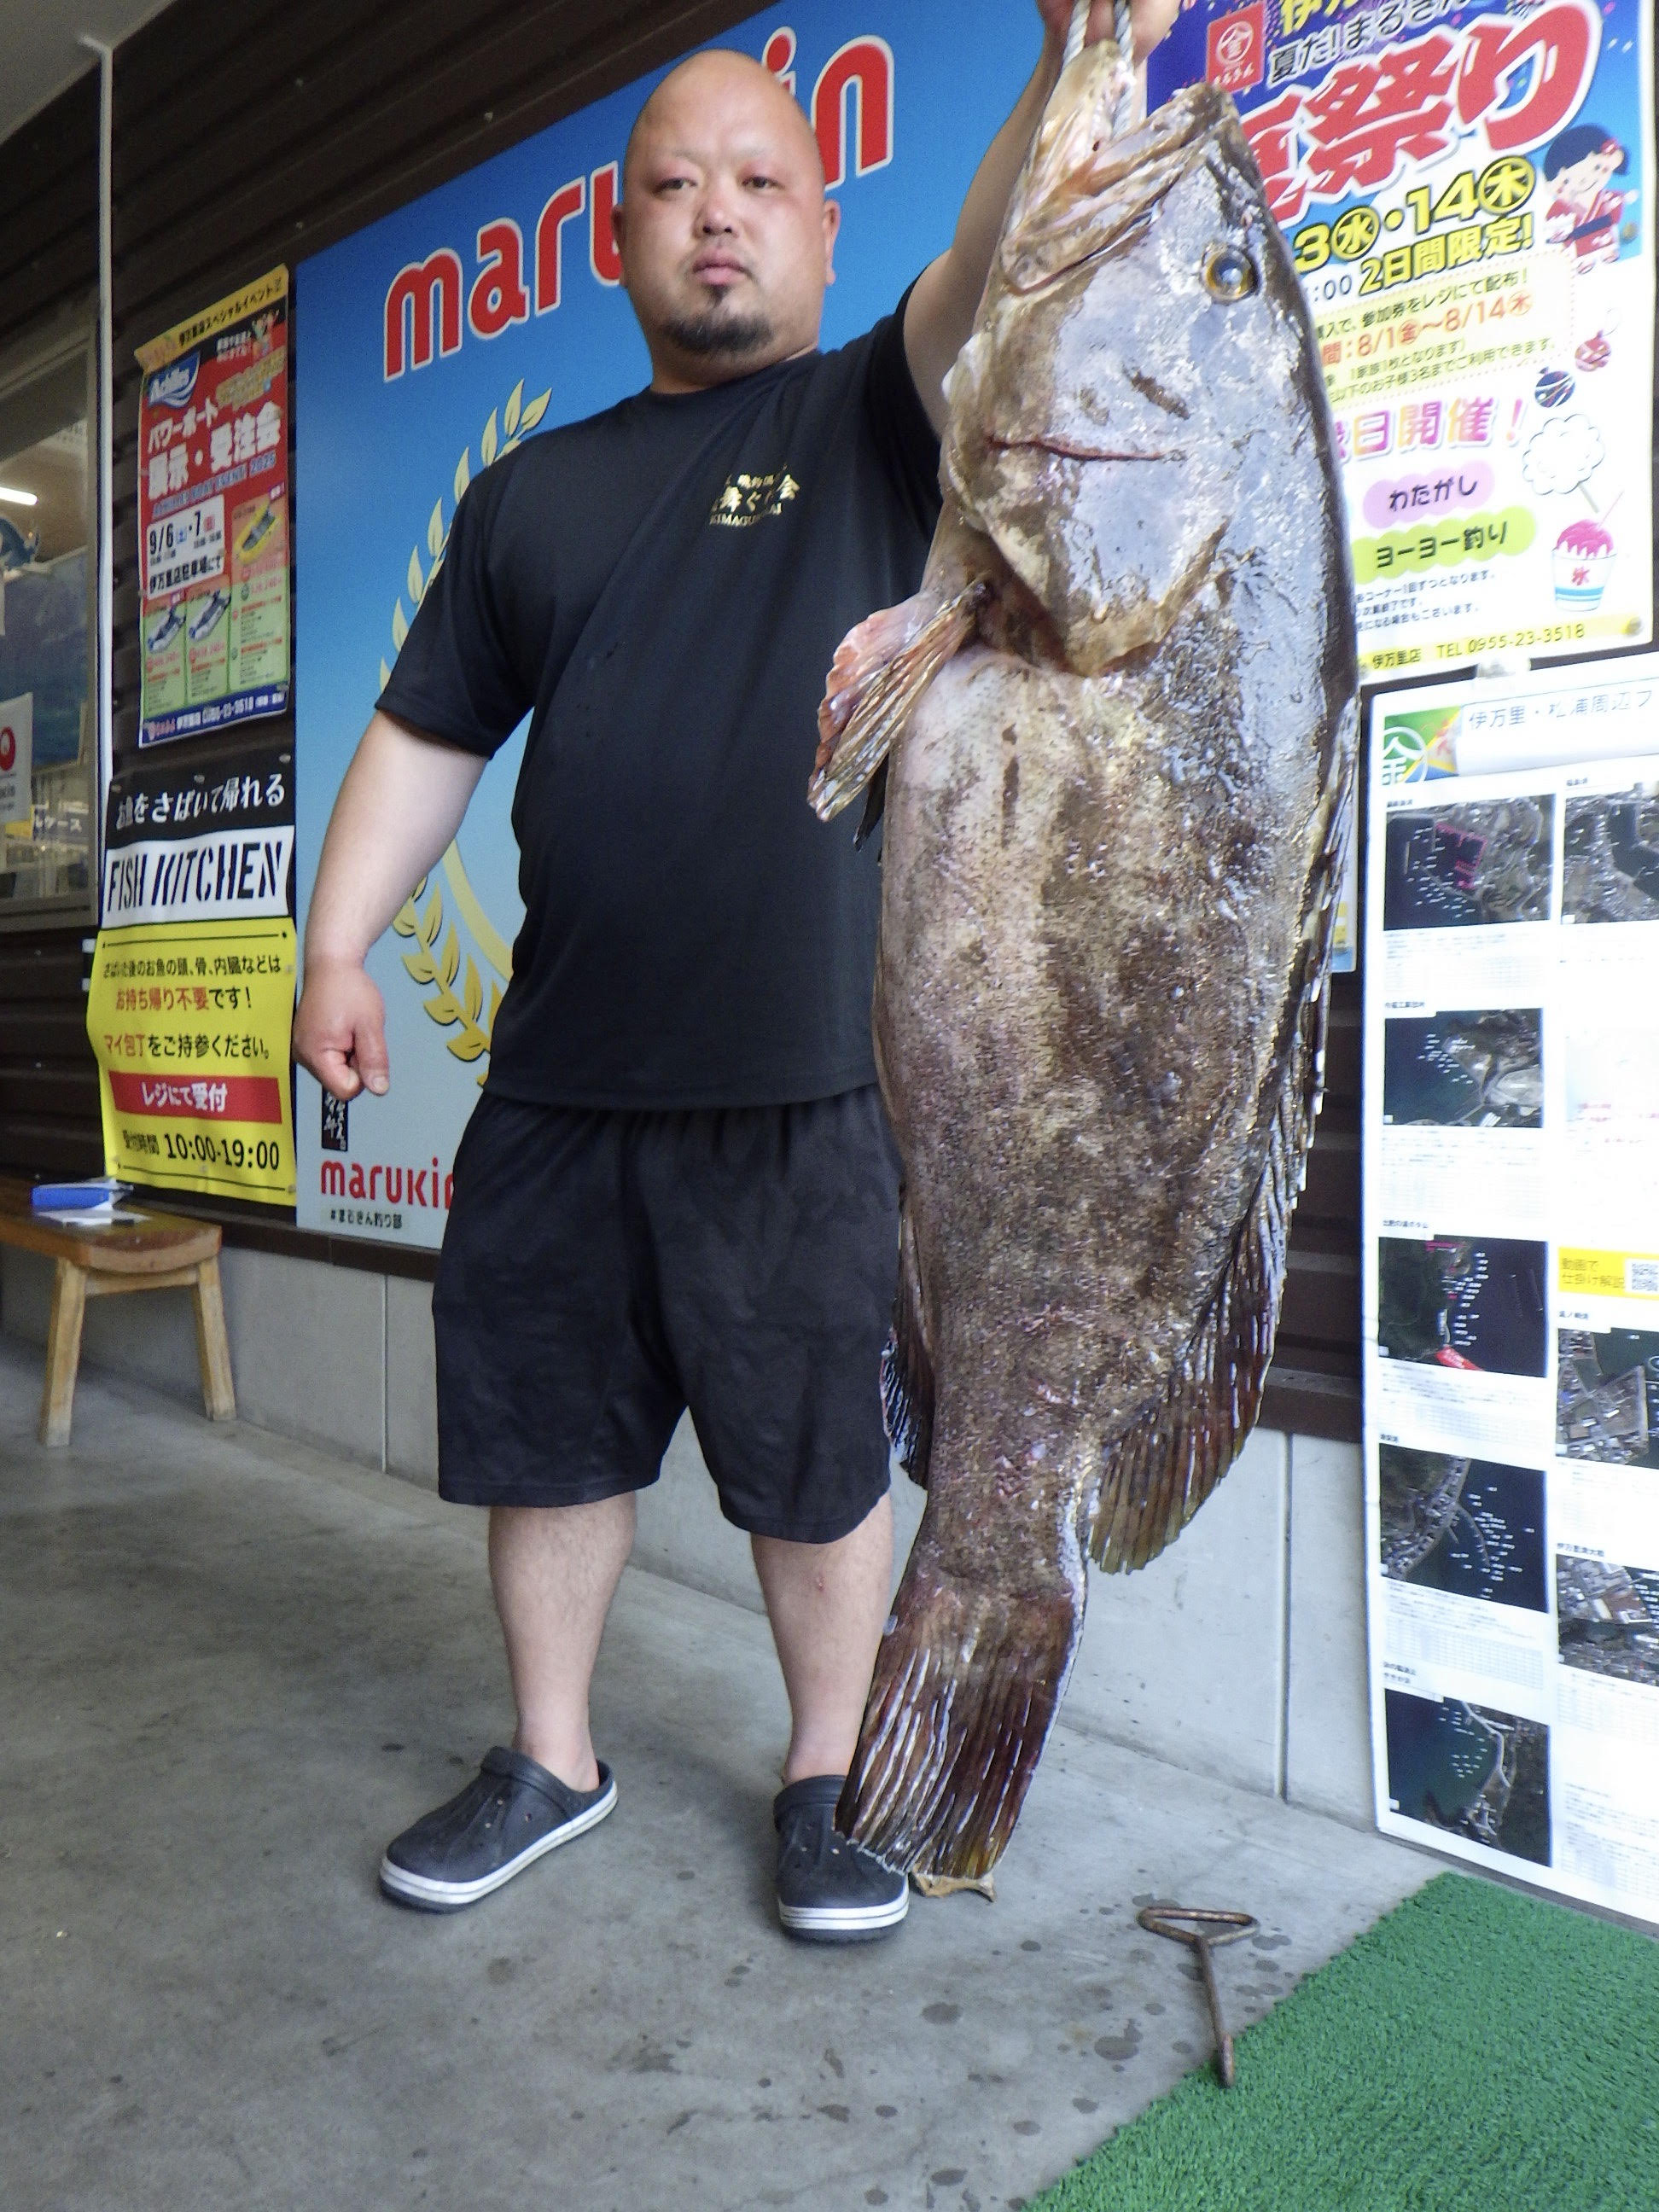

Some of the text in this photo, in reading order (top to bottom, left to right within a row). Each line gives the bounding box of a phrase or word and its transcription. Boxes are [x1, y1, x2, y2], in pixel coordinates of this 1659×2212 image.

[1336, 397, 1524, 459] 日開催!
[1388, 474, 1478, 513] わたがし
[1376, 520, 1509, 568] ヨーヨー釣り
[1436, 643, 1463, 661] TEL
[1467, 623, 1586, 655] 0955-23-3518
[108, 841, 282, 911] FISH KITCHEN
[115, 986, 253, 1011] お持ち帰り不要です!
[103, 1033, 270, 1060] マイ包丁をご持参ください。
[140, 1081, 228, 1113] レジにて受付
